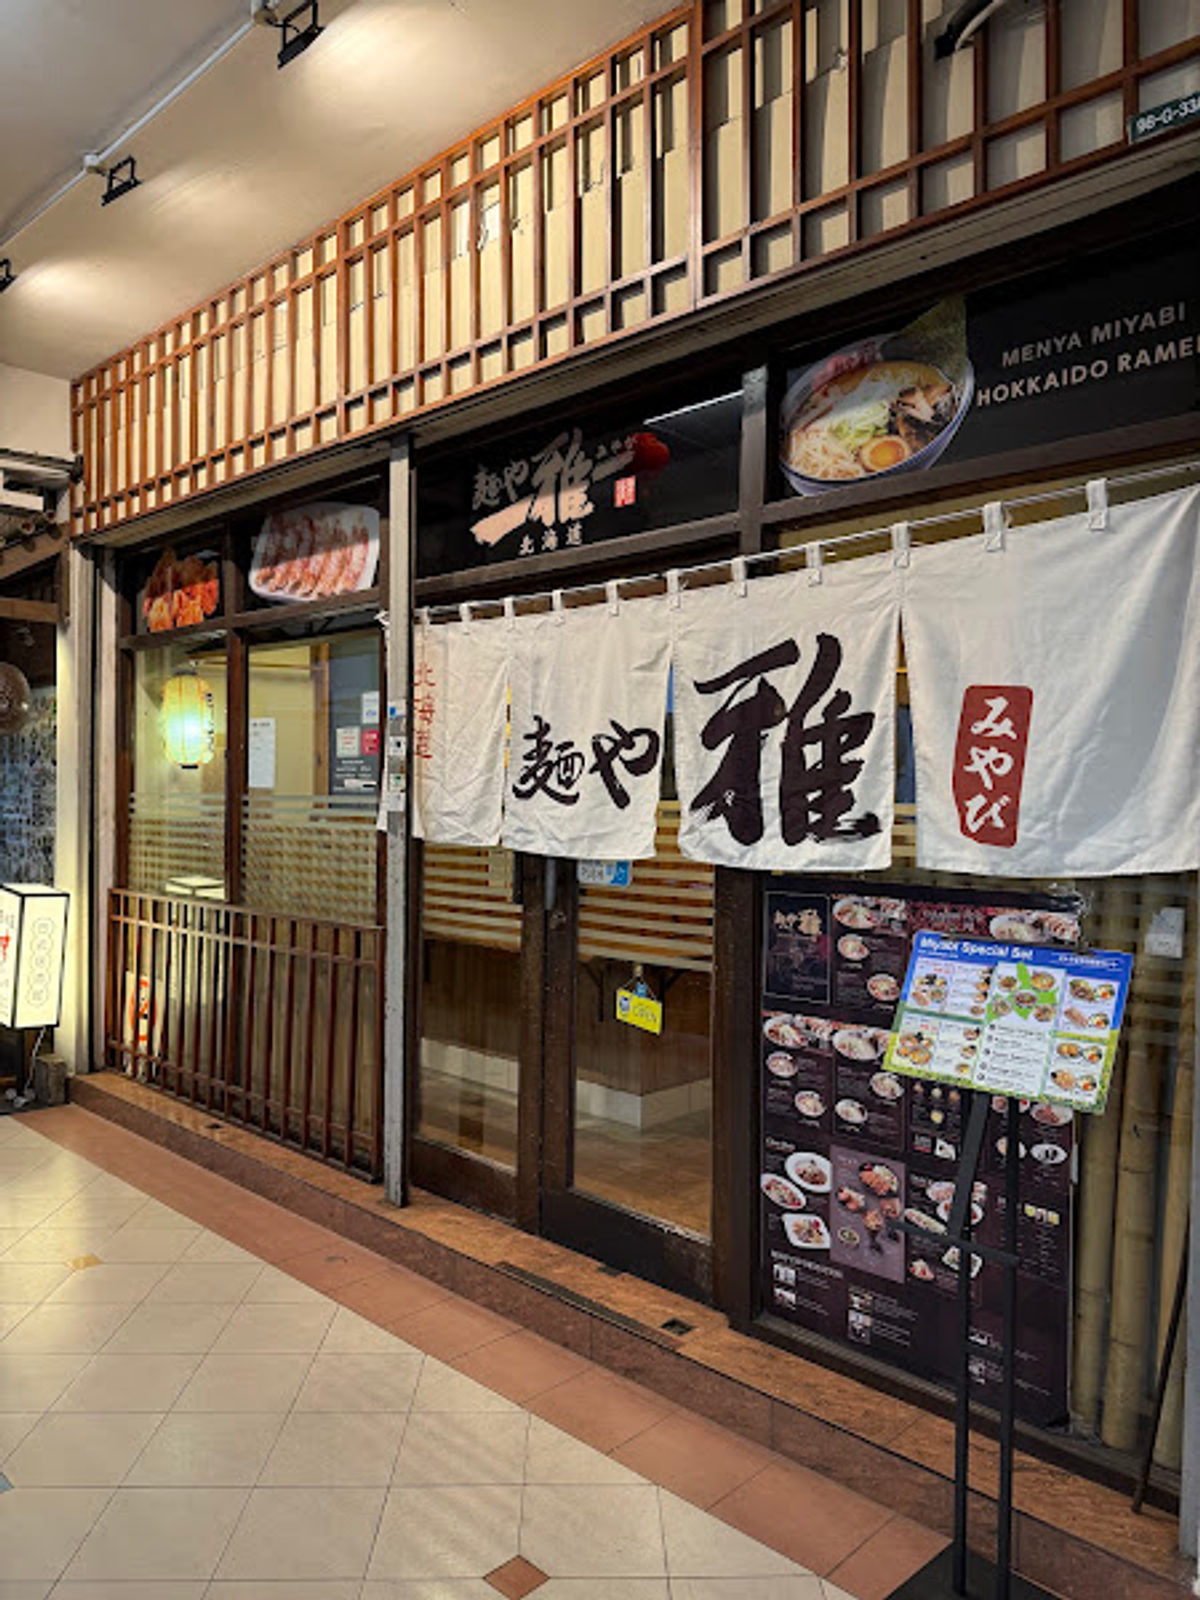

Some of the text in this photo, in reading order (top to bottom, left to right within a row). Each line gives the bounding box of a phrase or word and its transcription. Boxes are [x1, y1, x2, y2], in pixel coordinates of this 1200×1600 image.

[1002, 301, 1185, 368] MENYA MIYABI
[976, 359, 1109, 406] HOKKAIDO
[962, 697, 1018, 834] みやび
